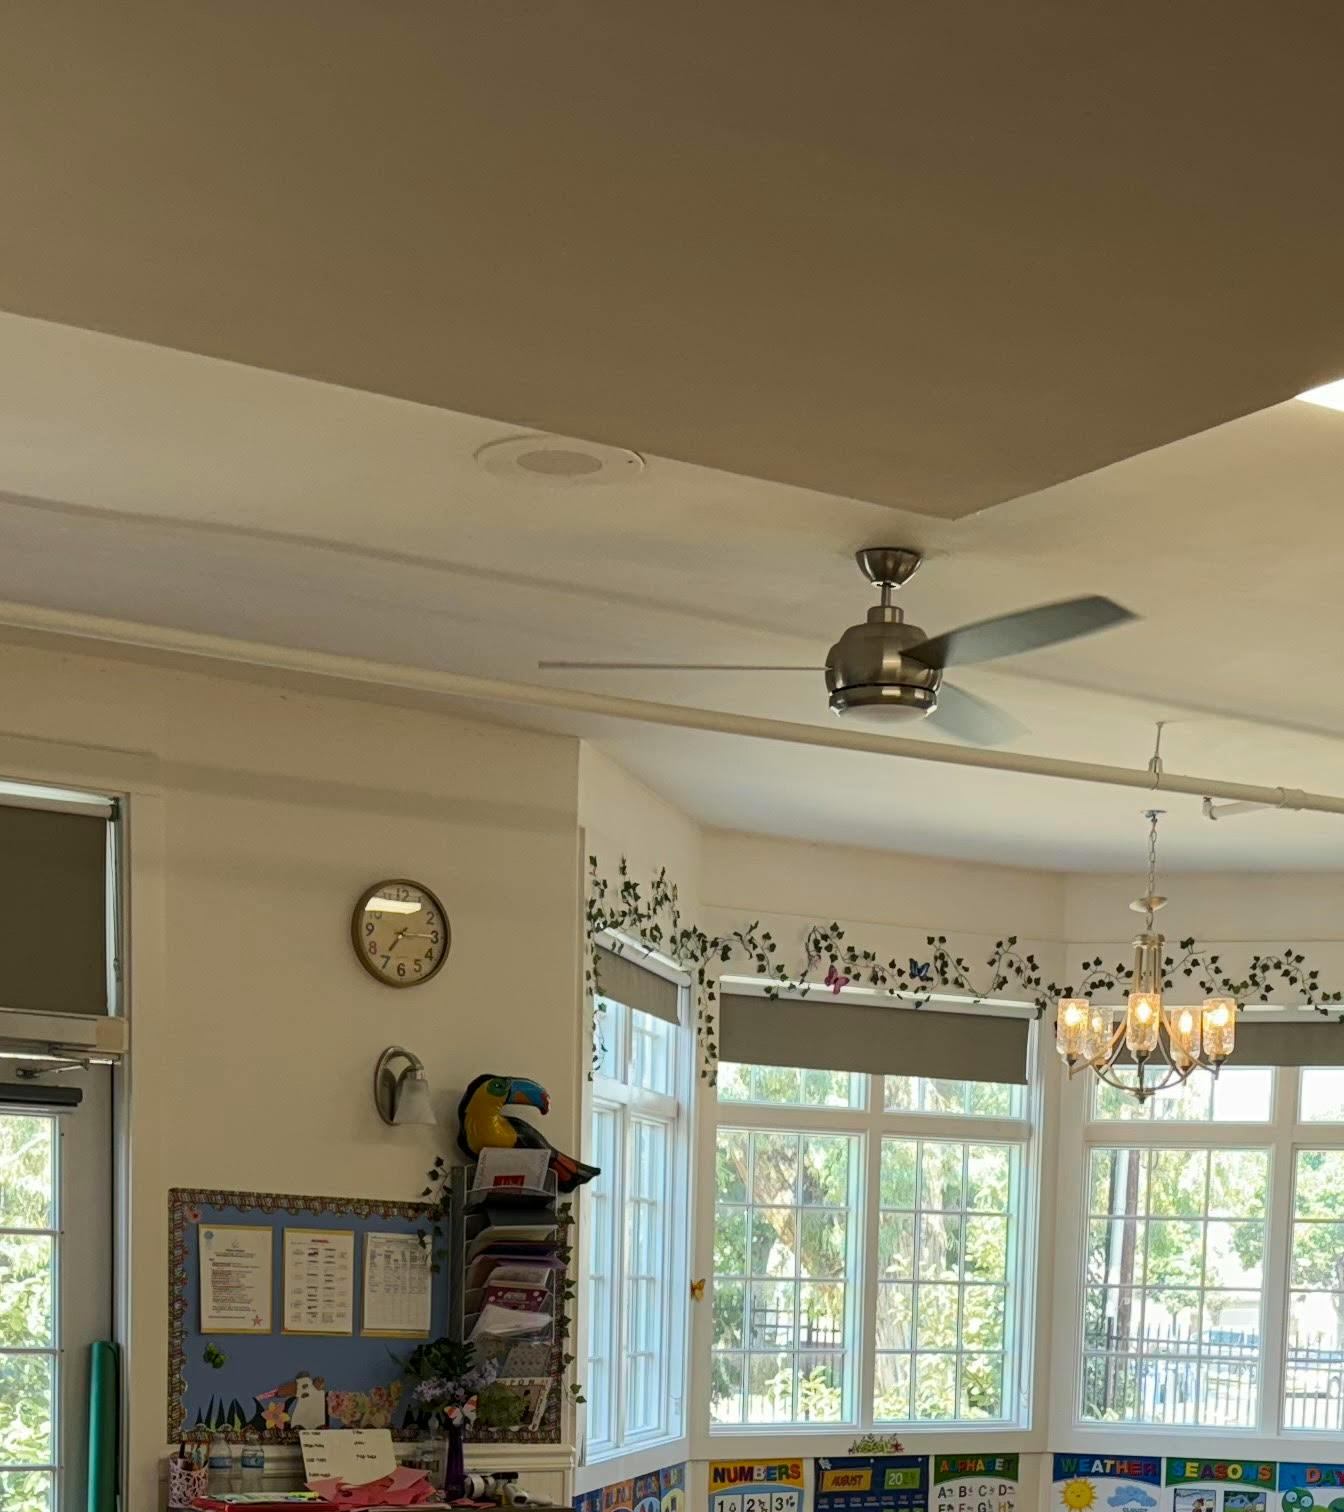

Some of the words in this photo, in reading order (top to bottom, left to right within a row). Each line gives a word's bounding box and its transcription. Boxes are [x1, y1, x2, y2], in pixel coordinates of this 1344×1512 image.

[396, 888, 410, 900] 12
[426, 912, 434, 925] 2
[366, 923, 374, 936] 9
[431, 930, 439, 944] 3
[368, 941, 377, 955] 8
[425, 948, 433, 961] 4
[381, 955, 390, 969] 7
[414, 960, 422, 972] 5
[397, 963, 405, 976] 6
[940, 1458, 1013, 1473] ALPHABET
[1061, 1458, 1155, 1475] WEATHER
[1173, 1462, 1274, 1481] SEASONS
[713, 1464, 800, 1483] NUMBERS
[888, 1472, 903, 1485] 20
[831, 1475, 863, 1487] AUGUST
[938, 1487, 946, 1498] A
[959, 1486, 966, 1497] B
[979, 1485, 987, 1496] C
[998, 1485, 1006, 1496] D
[747, 1499, 755, 1512] 2
[775, 1498, 783, 1511] 3
[998, 1502, 1006, 1512] H
